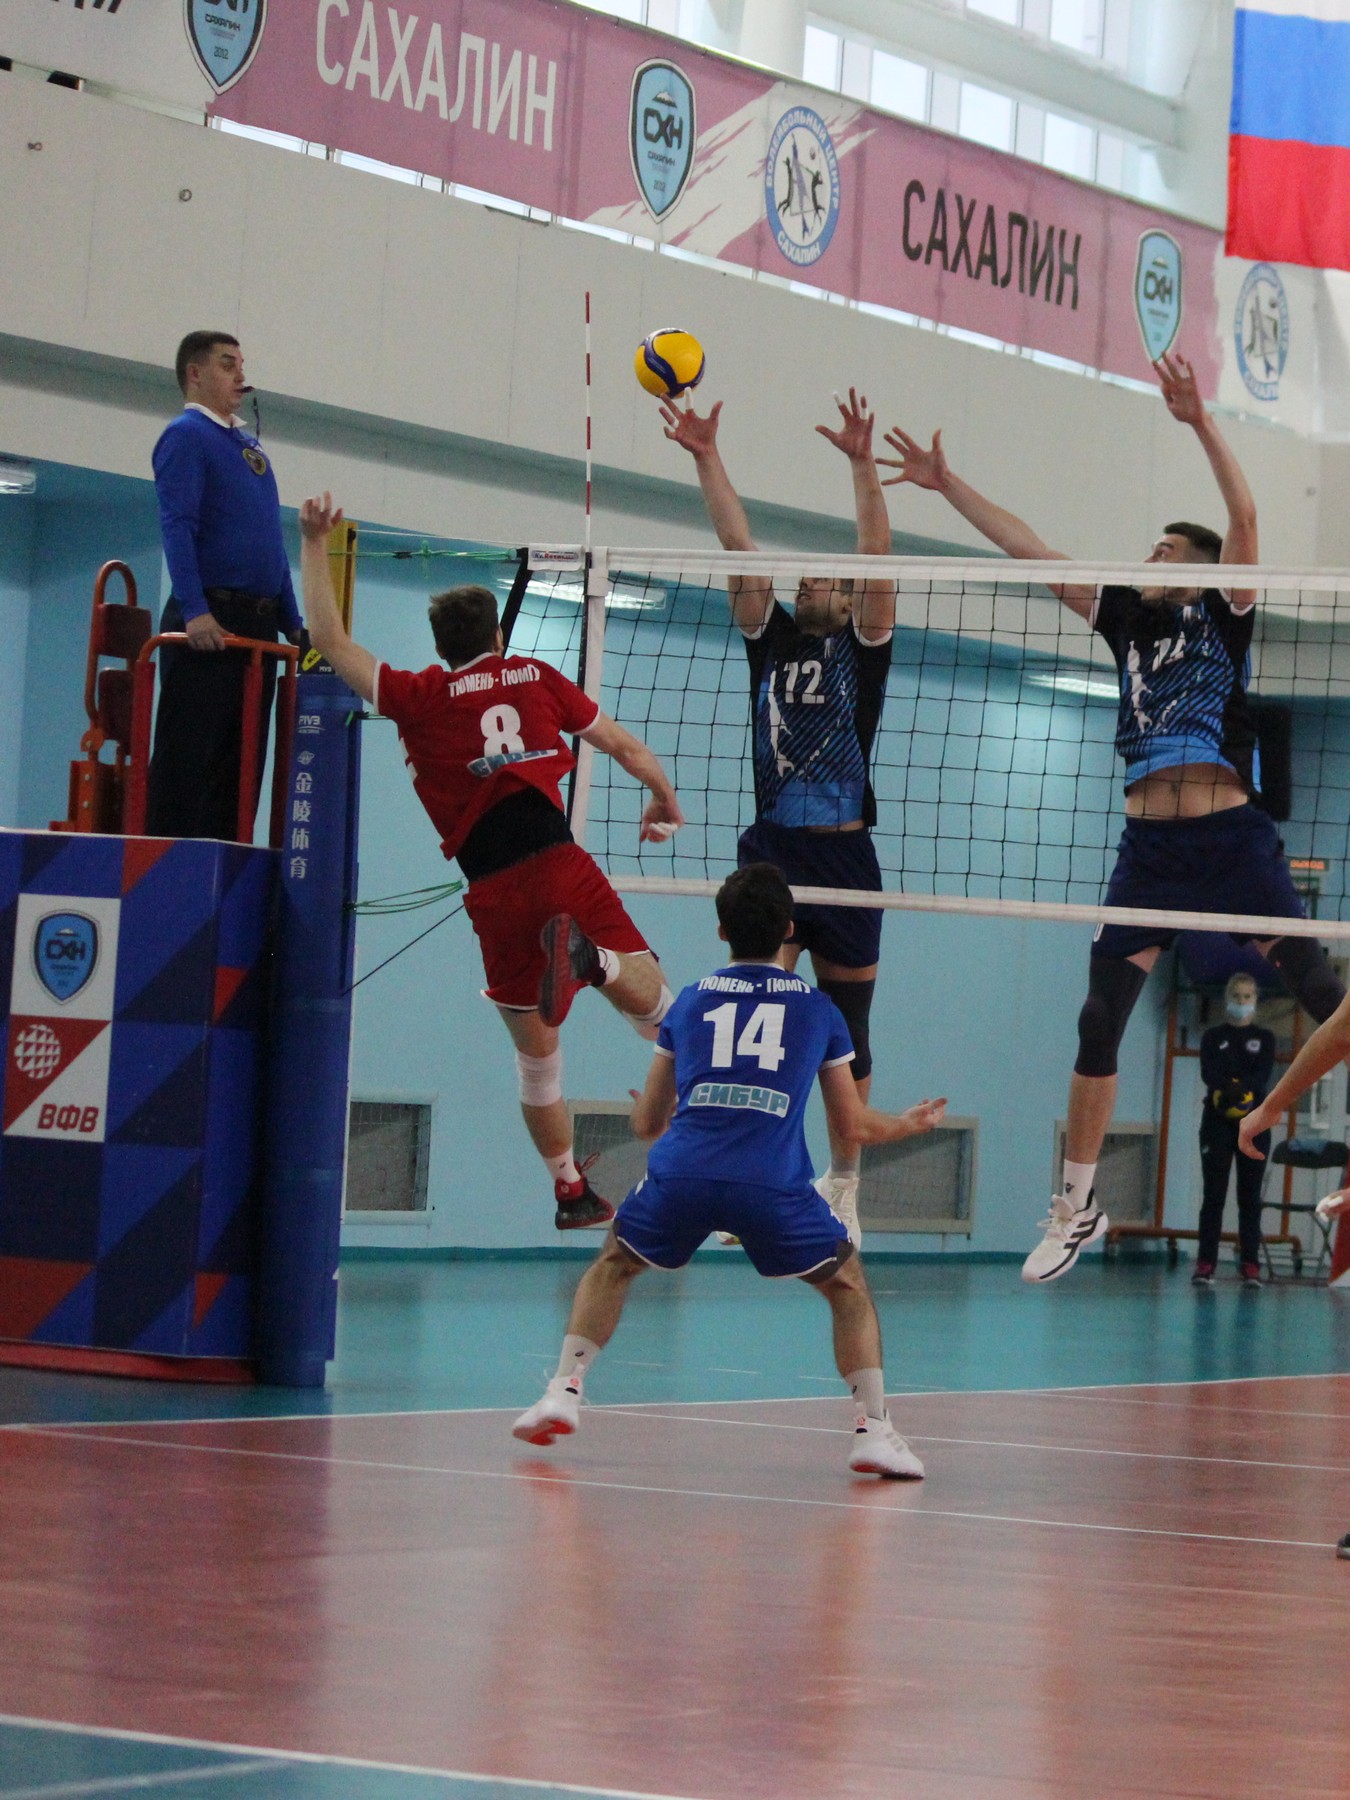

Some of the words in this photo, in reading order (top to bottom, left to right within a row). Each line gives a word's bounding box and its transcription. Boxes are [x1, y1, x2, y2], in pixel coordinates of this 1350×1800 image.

[317, 0, 557, 151] САХАЛИН
[777, 230, 821, 264] САХАЛИН
[902, 179, 1082, 311] САХАЛИН
[448, 672, 495, 698] ТЮМЕНЬ
[783, 659, 825, 704] 12
[480, 703, 526, 758] 8
[698, 975, 755, 993] ТЮМЕНЬ
[702, 1002, 787, 1072] 14
[37, 1103, 100, 1133] ВФВ
[691, 1085, 788, 1114] СИБУР
